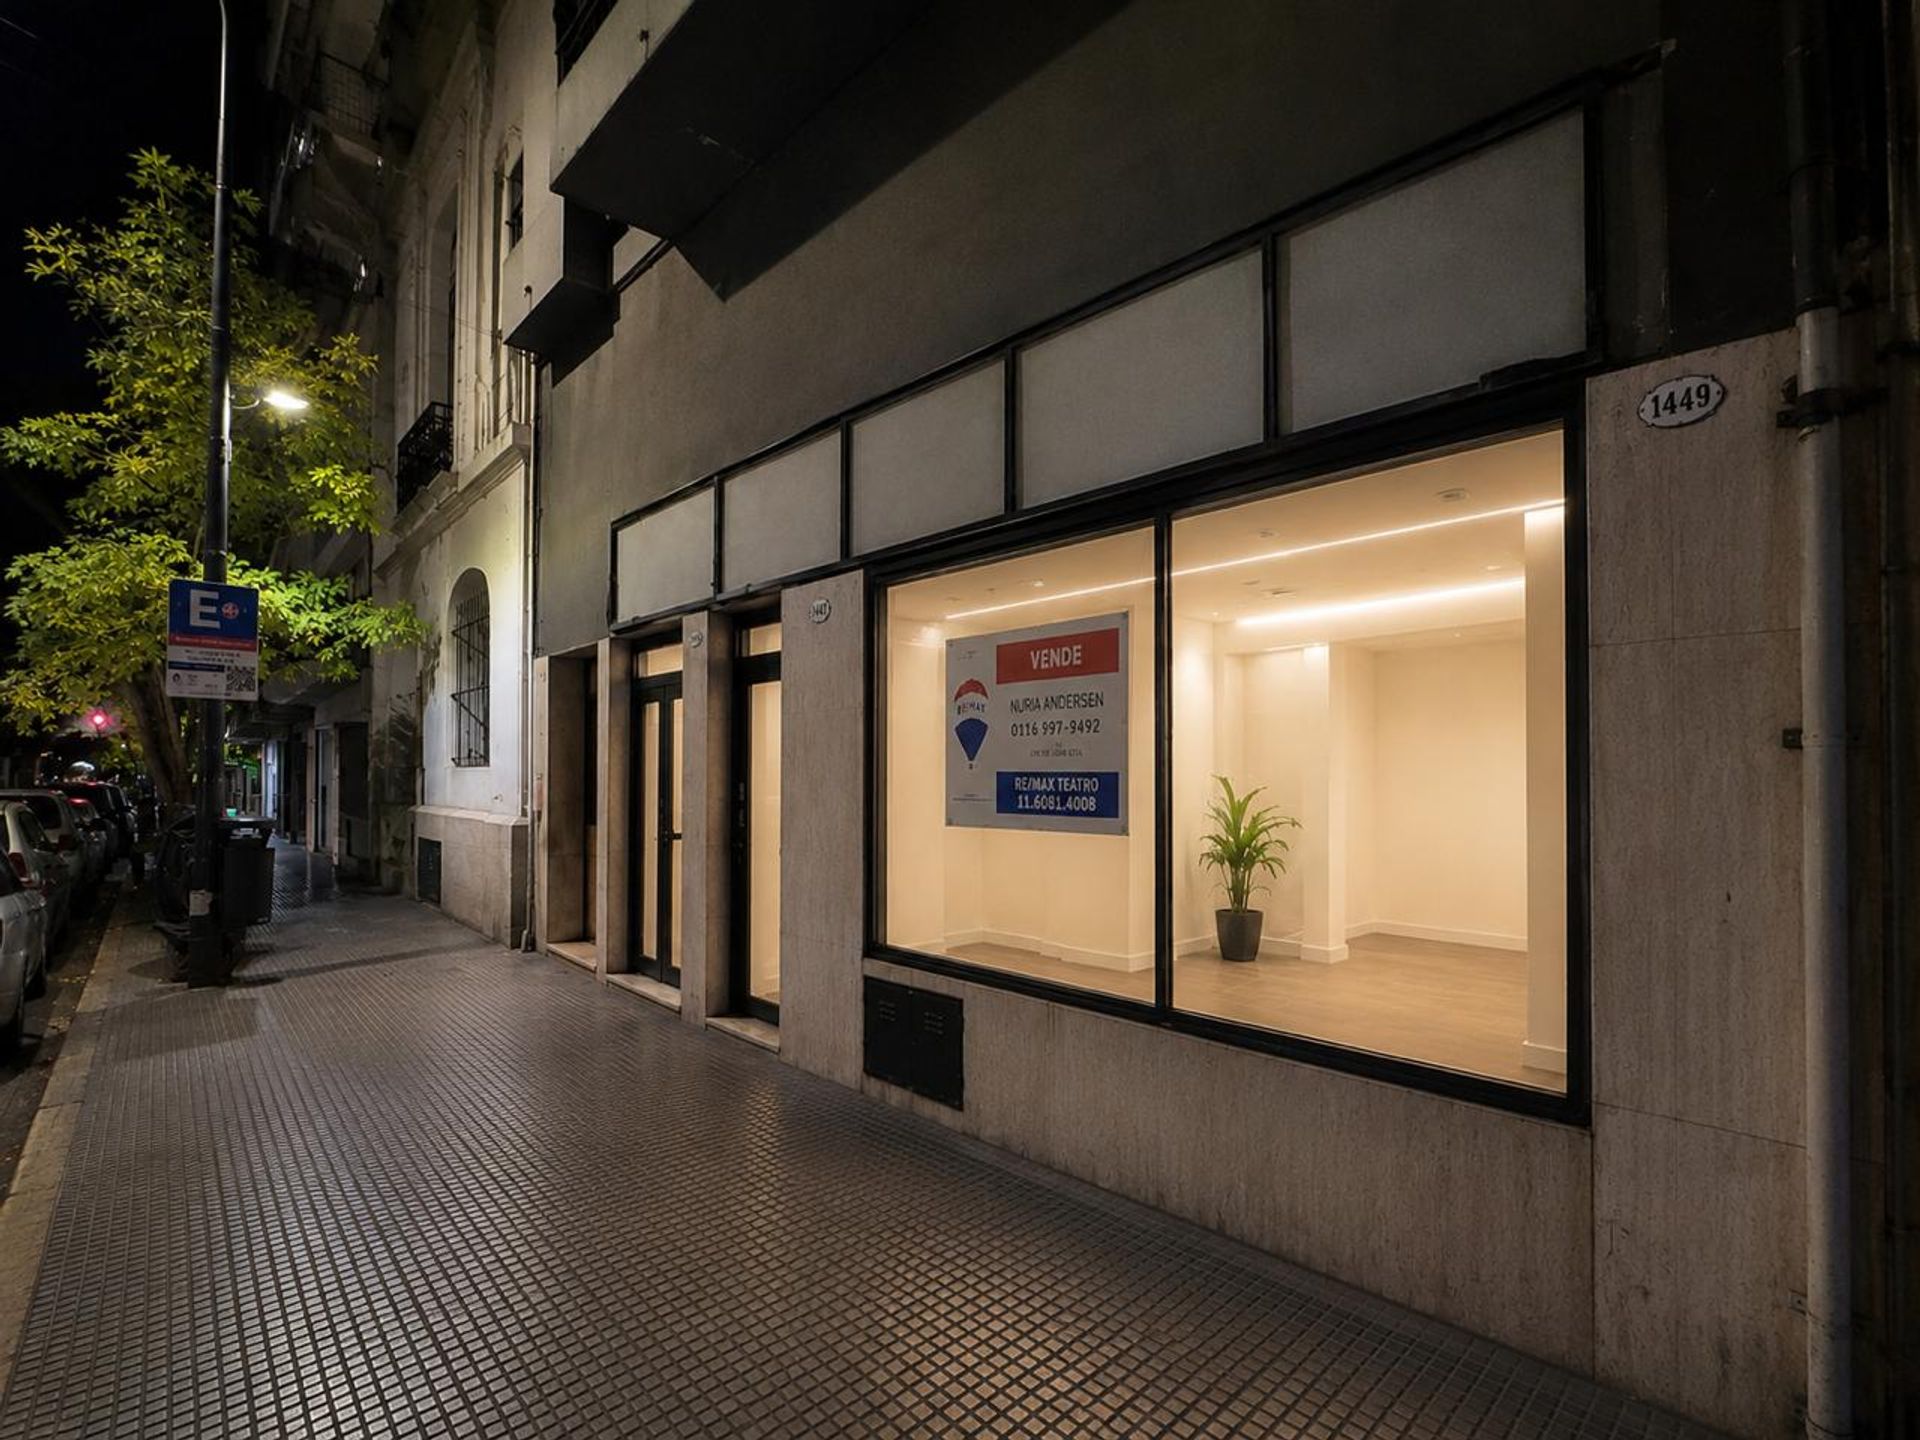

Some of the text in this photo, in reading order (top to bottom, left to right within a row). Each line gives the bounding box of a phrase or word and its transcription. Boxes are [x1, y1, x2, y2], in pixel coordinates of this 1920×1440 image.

[1651, 383, 1710, 418] 1449
[190, 589, 220, 629] E
[1030, 645, 1082, 670] VENDE
[1010, 692, 1104, 713] NURIA ANDERSEN
[1011, 718, 1101, 737] 0116 997-9492
[1014, 776, 1099, 793] RE/MAX TEATRO
